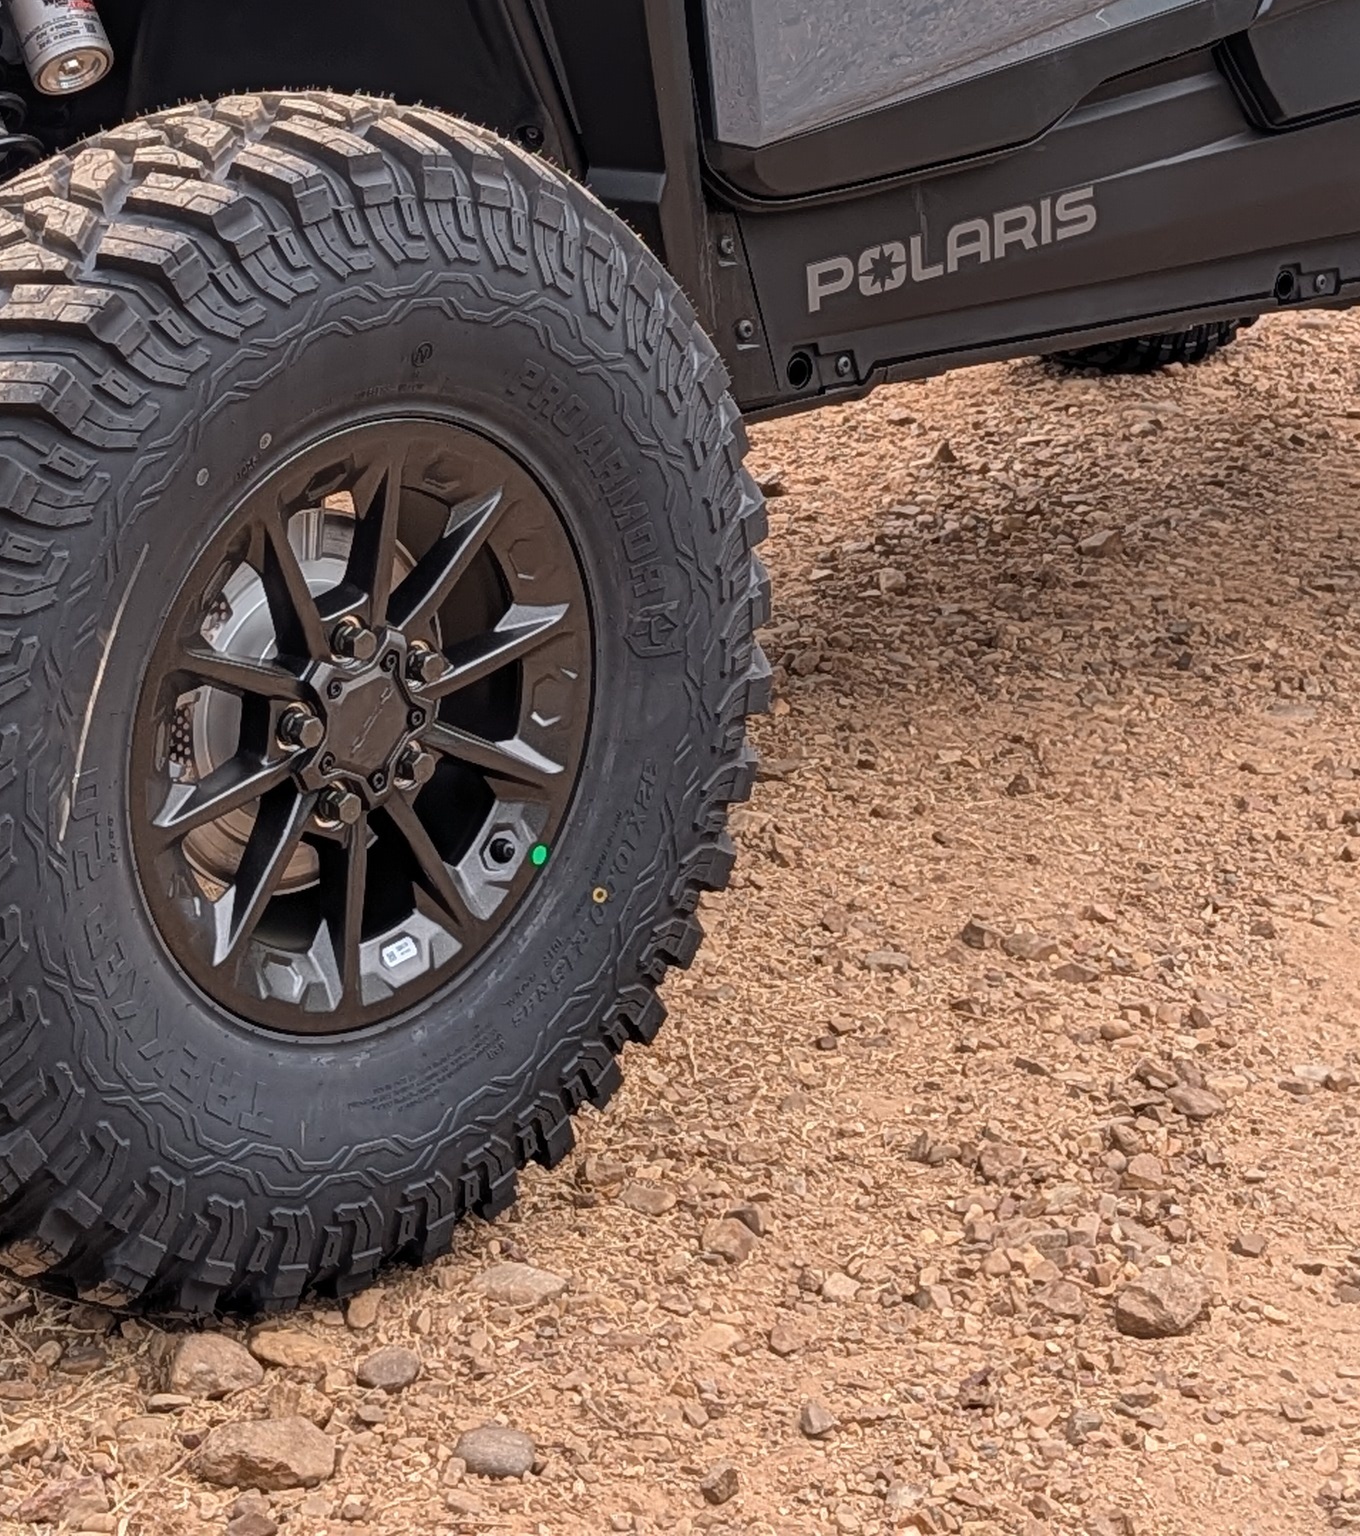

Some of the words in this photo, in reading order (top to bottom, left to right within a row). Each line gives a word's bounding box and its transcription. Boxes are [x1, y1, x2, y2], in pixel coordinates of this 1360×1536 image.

[804, 184, 1099, 313] POLARIS
[506, 357, 590, 438] PRO
[573, 424, 665, 599] ARMOR
